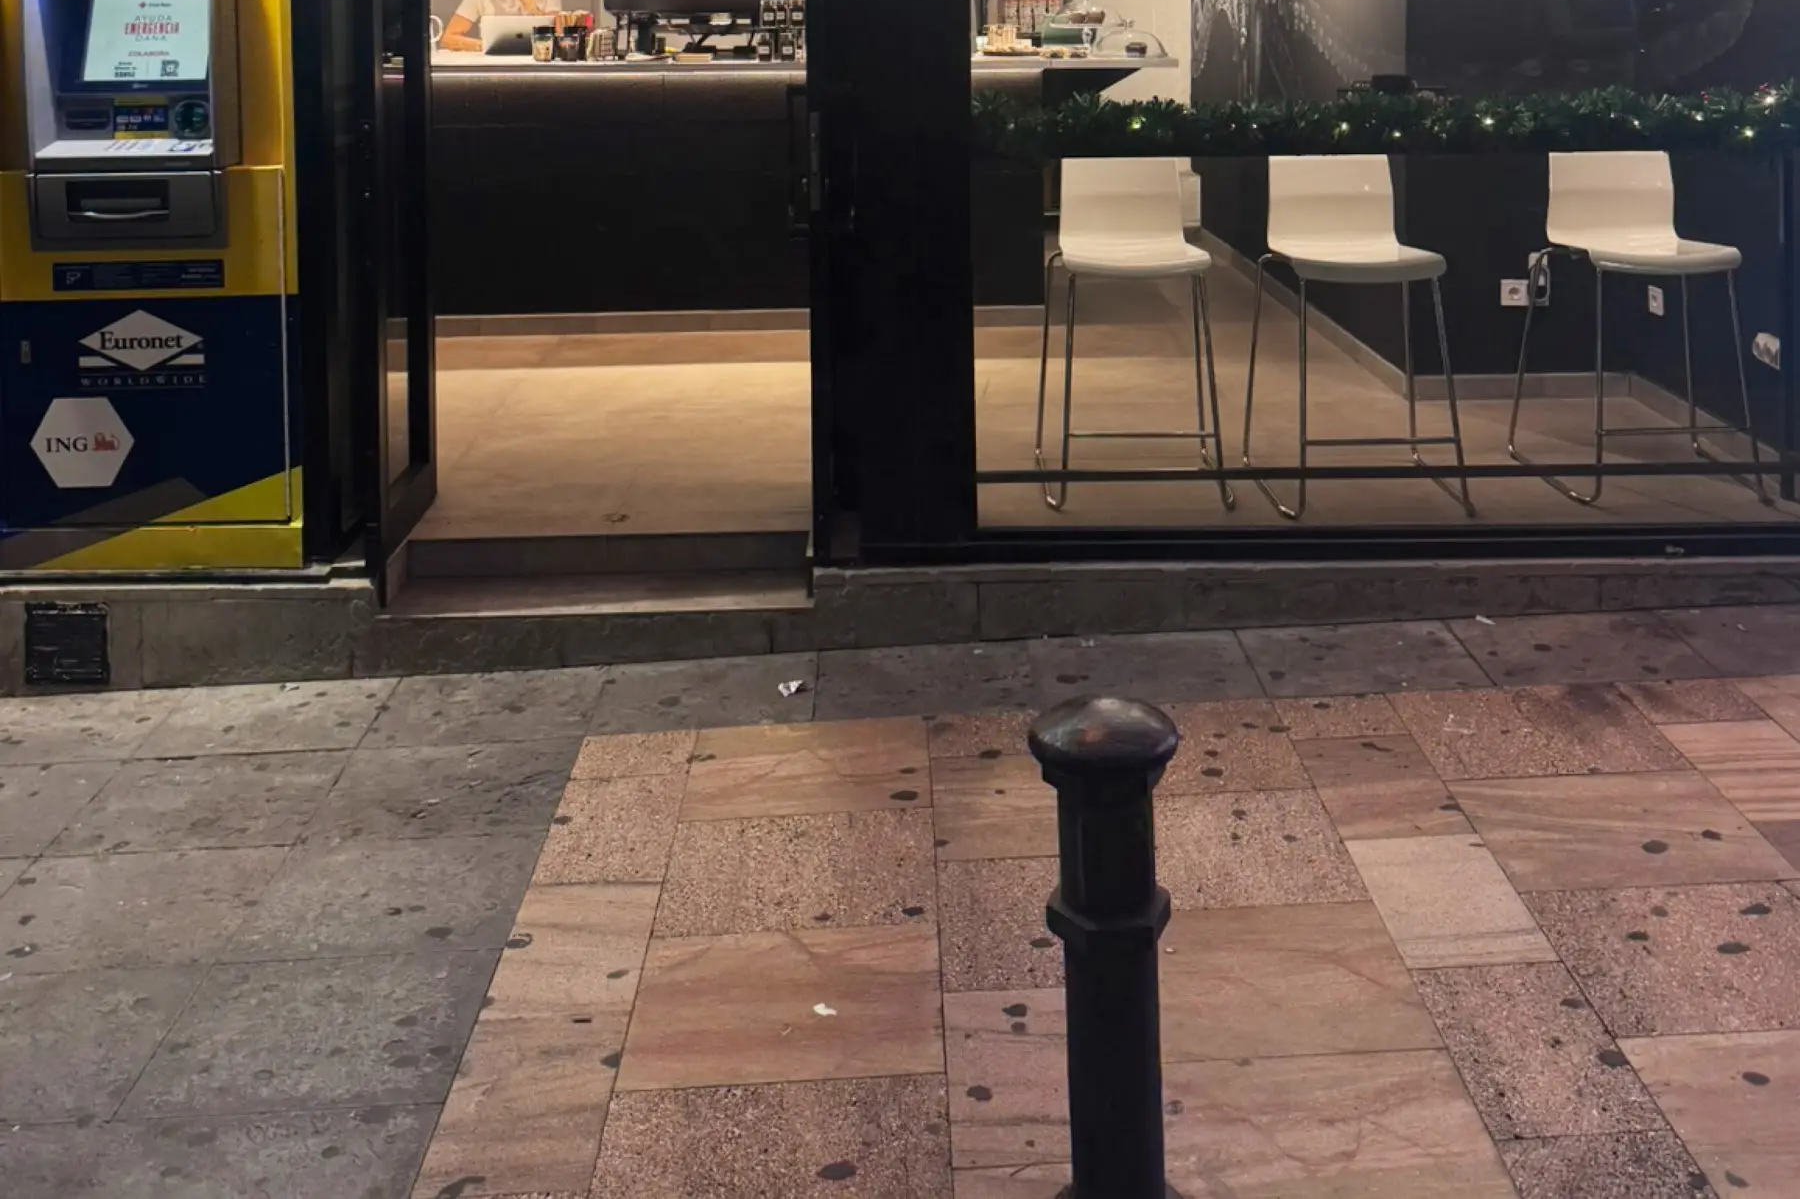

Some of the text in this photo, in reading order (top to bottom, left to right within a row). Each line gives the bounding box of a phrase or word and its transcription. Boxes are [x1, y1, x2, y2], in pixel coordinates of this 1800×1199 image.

[124, 21, 180, 35] EMERGENCIA
[99, 331, 184, 351] Euronet
[80, 374, 207, 387] WORLDWIDE
[45, 435, 88, 454] ING
